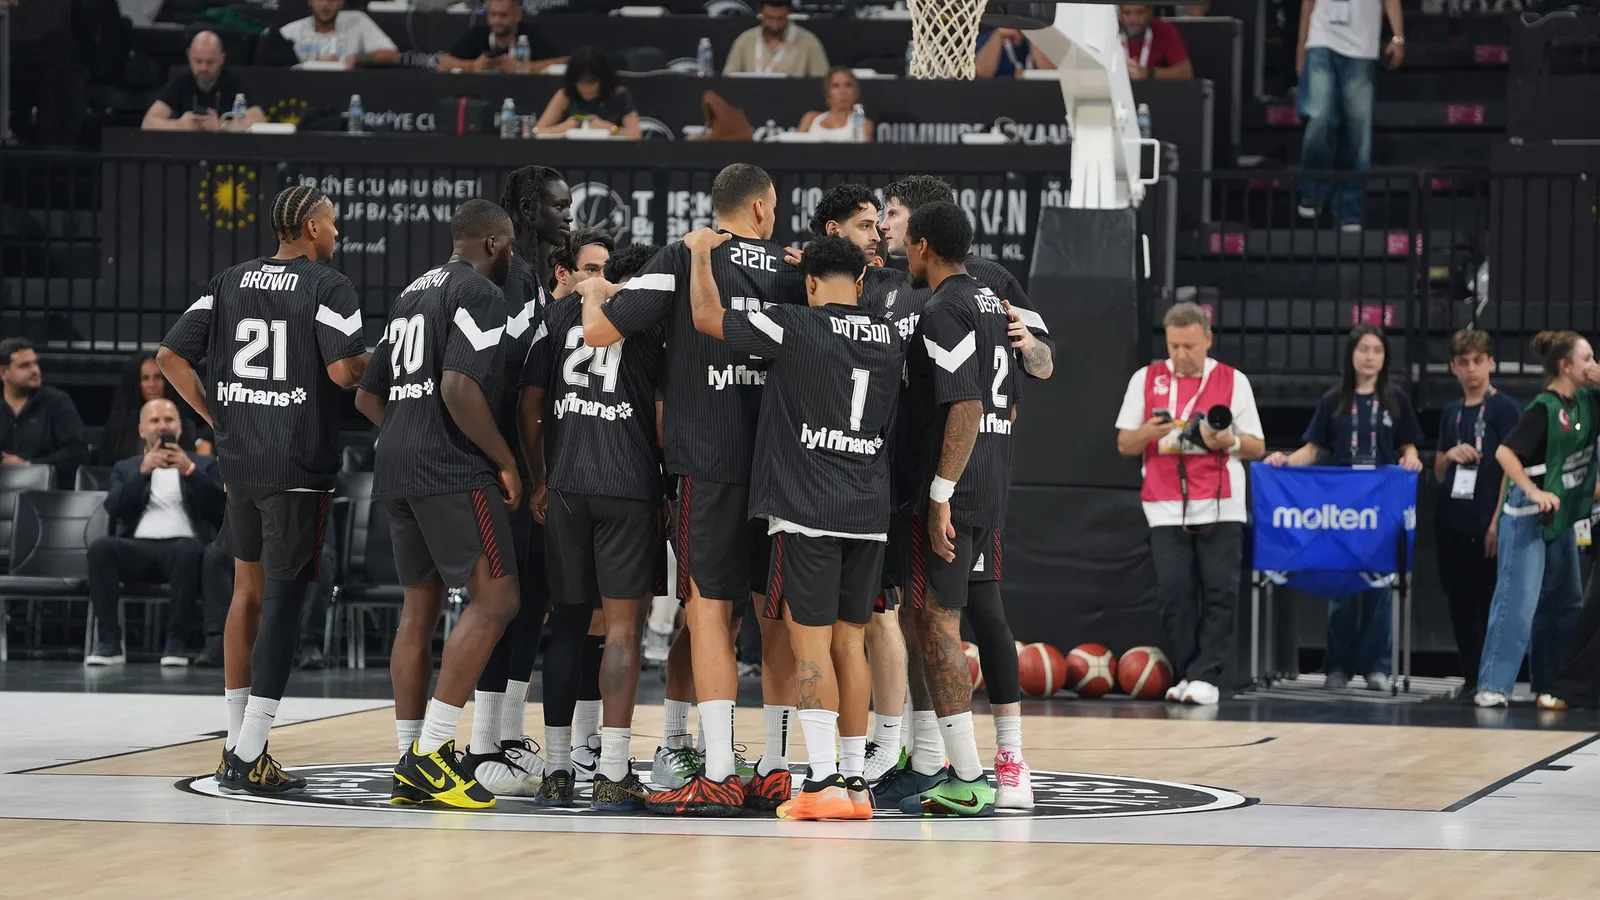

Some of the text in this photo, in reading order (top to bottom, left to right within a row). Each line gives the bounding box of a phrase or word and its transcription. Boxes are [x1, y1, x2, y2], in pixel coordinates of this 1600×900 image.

[239, 270, 299, 291] BROWN
[232, 318, 288, 381] 21
[388, 313, 425, 380] 20
[562, 325, 624, 393] 24
[829, 316, 890, 345] DOTSON
[850, 368, 870, 431] 1
[991, 345, 1009, 408] 2
[1272, 504, 1378, 530] molten
